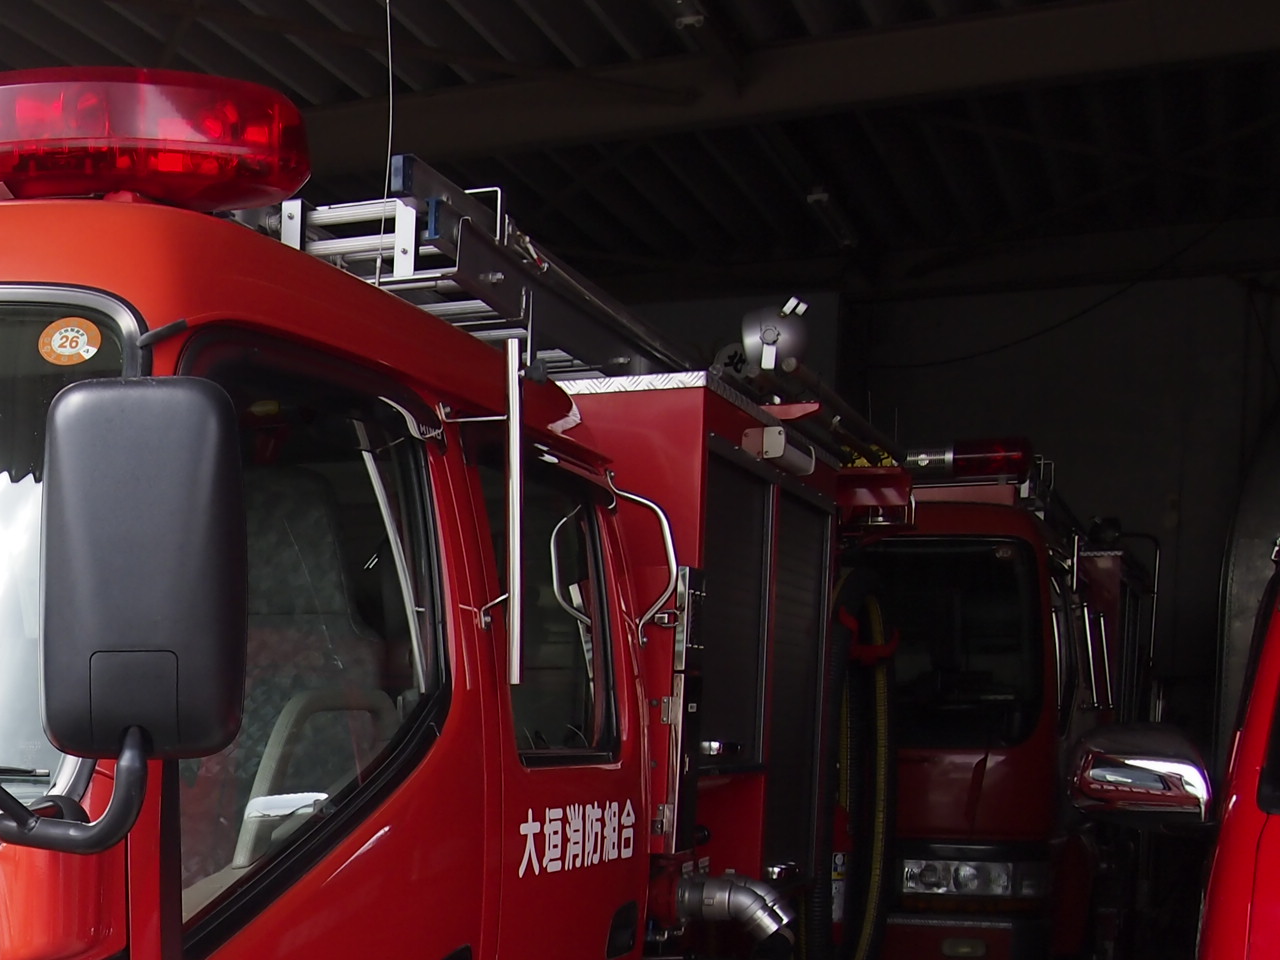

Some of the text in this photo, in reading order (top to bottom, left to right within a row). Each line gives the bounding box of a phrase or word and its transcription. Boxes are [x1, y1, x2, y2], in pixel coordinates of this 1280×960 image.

[57, 334, 80, 349] 26
[518, 798, 636, 879] 大垣消防組合
